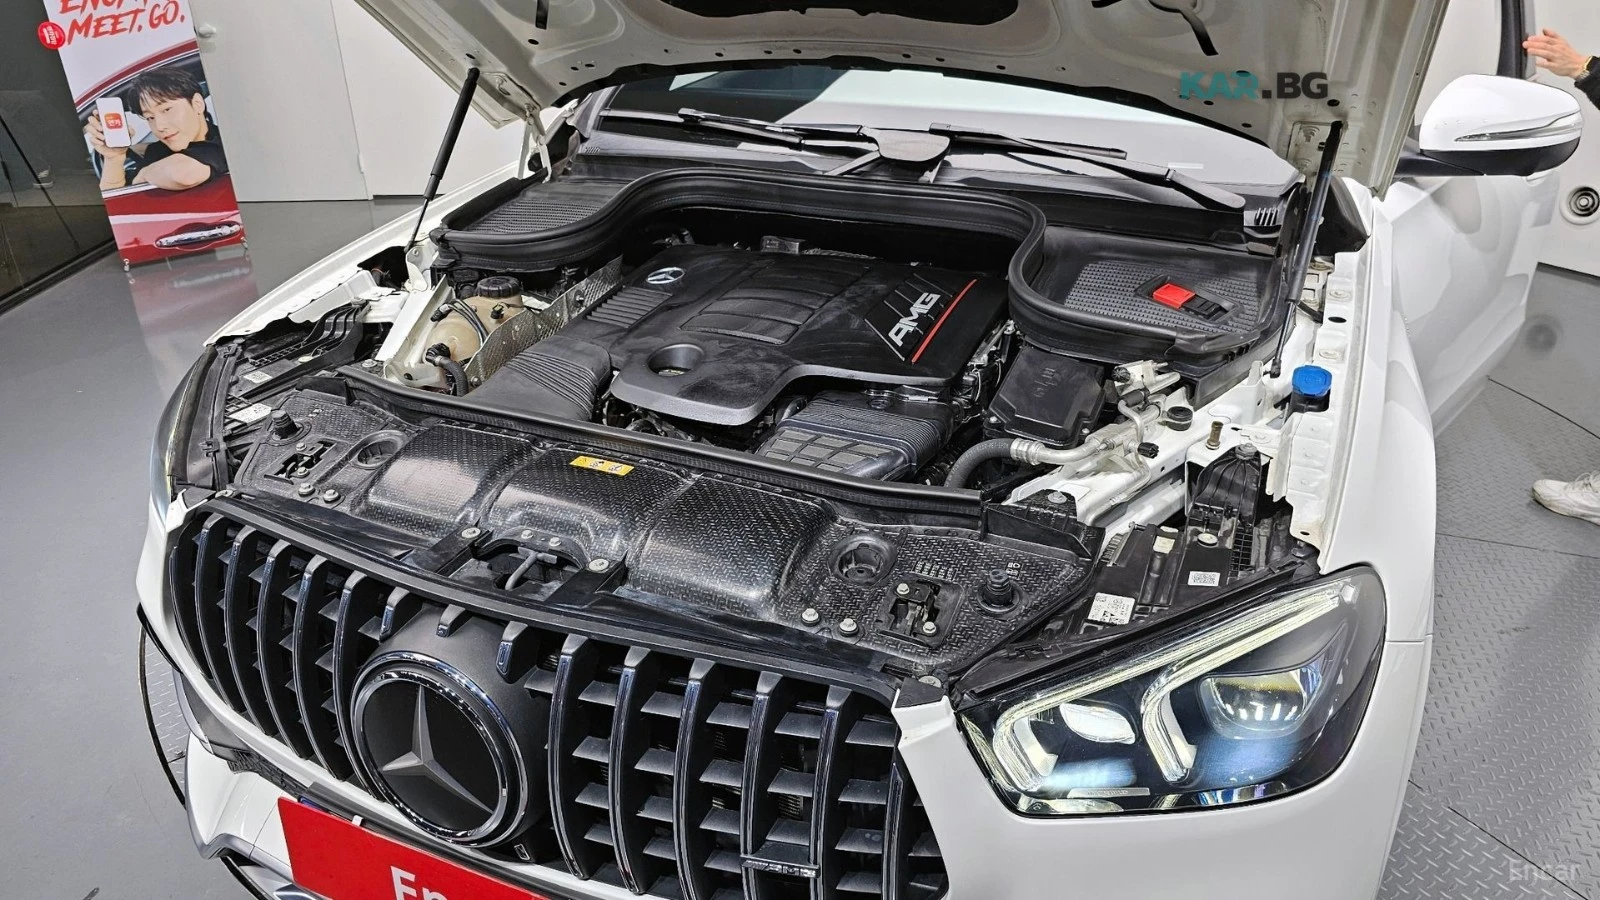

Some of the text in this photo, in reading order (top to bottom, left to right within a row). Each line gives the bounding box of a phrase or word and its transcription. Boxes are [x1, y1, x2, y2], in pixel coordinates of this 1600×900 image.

[67, 8, 145, 45] MEET.
[149, 0, 185, 29] GO.
[888, 292, 941, 347] AMG
